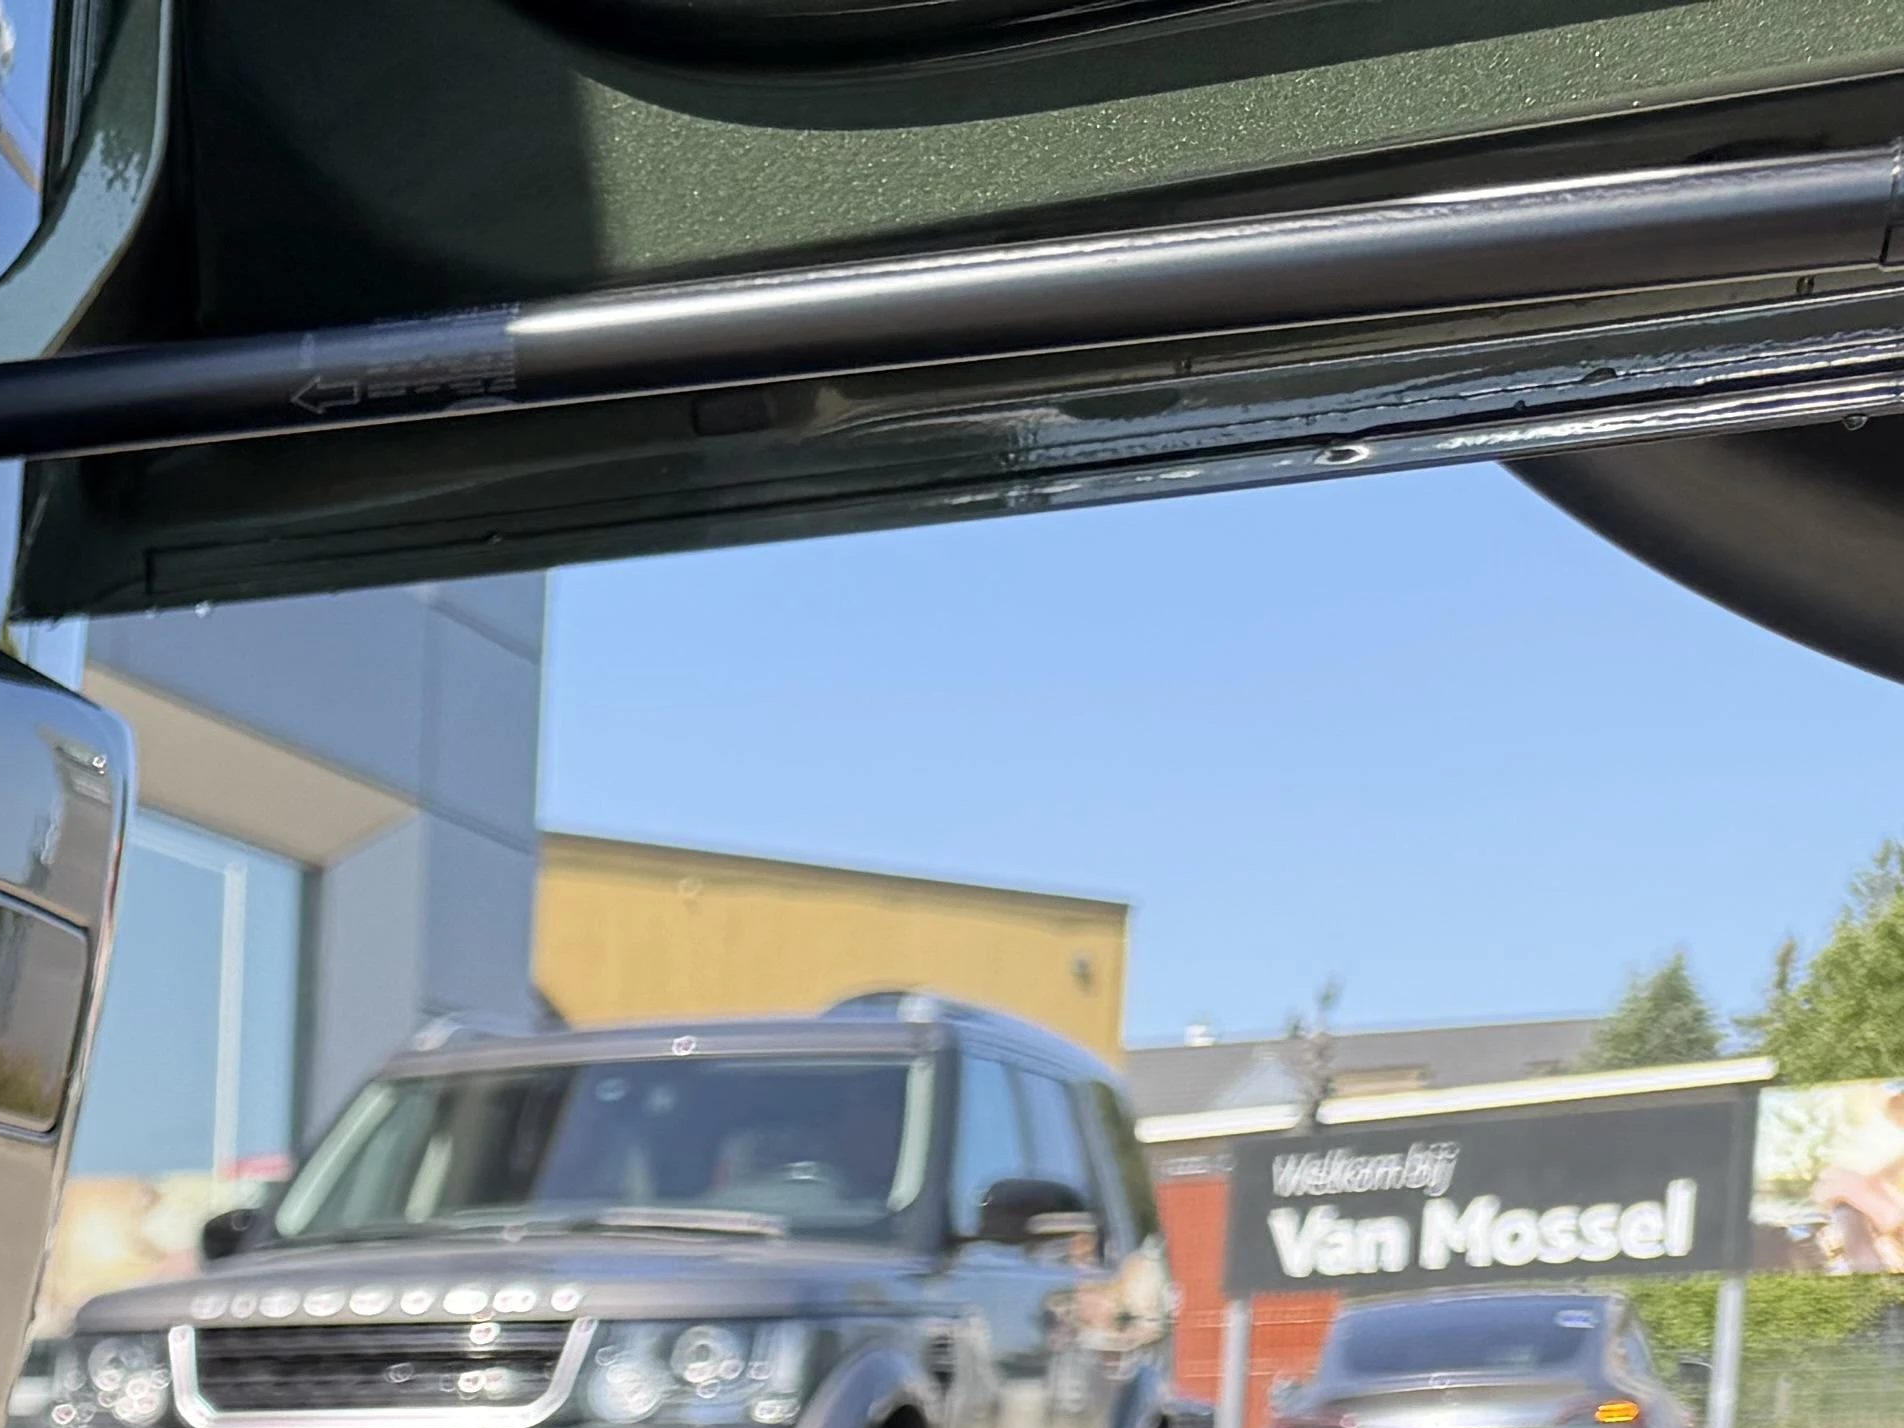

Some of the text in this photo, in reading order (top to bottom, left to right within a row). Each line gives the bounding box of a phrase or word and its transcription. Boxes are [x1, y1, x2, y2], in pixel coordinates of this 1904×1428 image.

[1272, 1151, 1403, 1198] Welkom
[1267, 1178, 1698, 1278] Van Mossel
